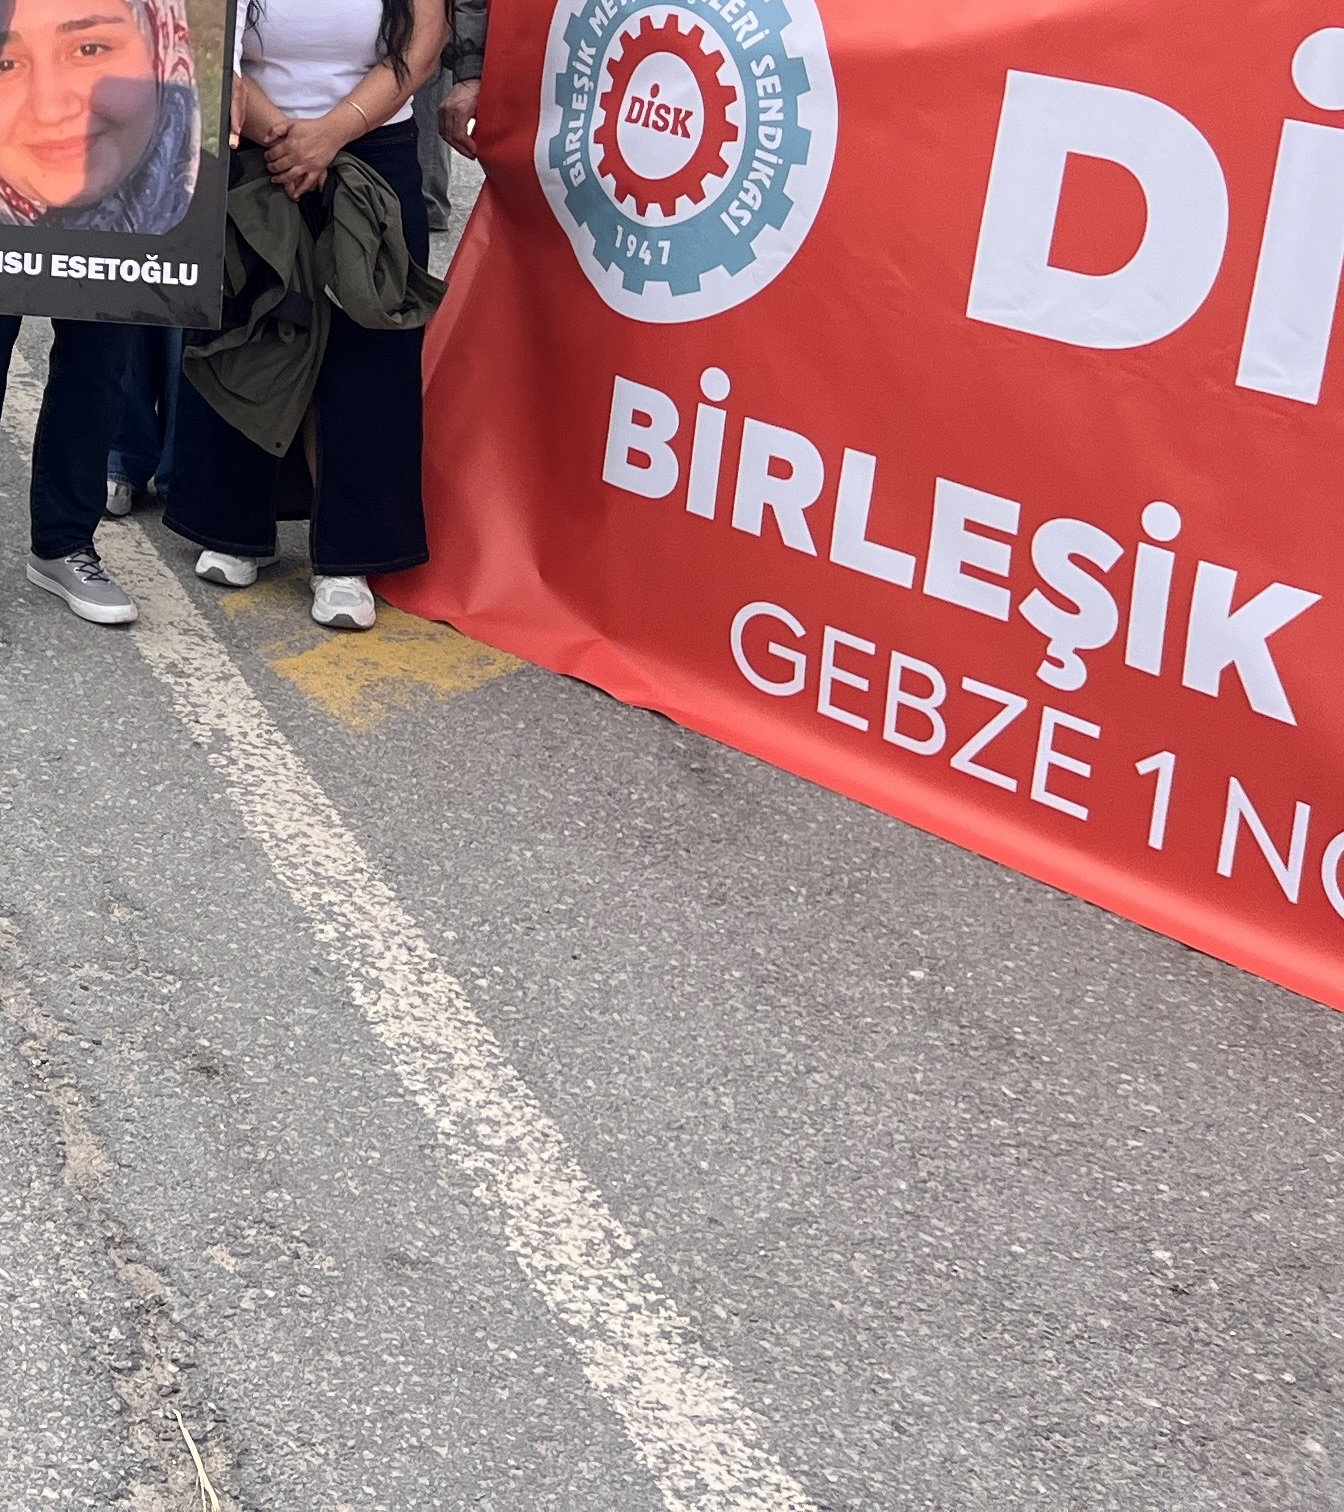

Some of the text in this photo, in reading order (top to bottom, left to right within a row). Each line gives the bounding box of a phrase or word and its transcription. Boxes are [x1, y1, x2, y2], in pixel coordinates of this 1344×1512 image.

[562, 38, 597, 188] BİRLEŞİK
[719, 53, 786, 236] SENDİKASI
[625, 83, 694, 139] DİSK
[50, 253, 199, 286] ESETOĞLU
[615, 224, 671, 265] 1947
[601, 366, 1323, 727] BİRLEŞİK
[729, 600, 1102, 822] GEBZE
[1135, 750, 1176, 851] 1
